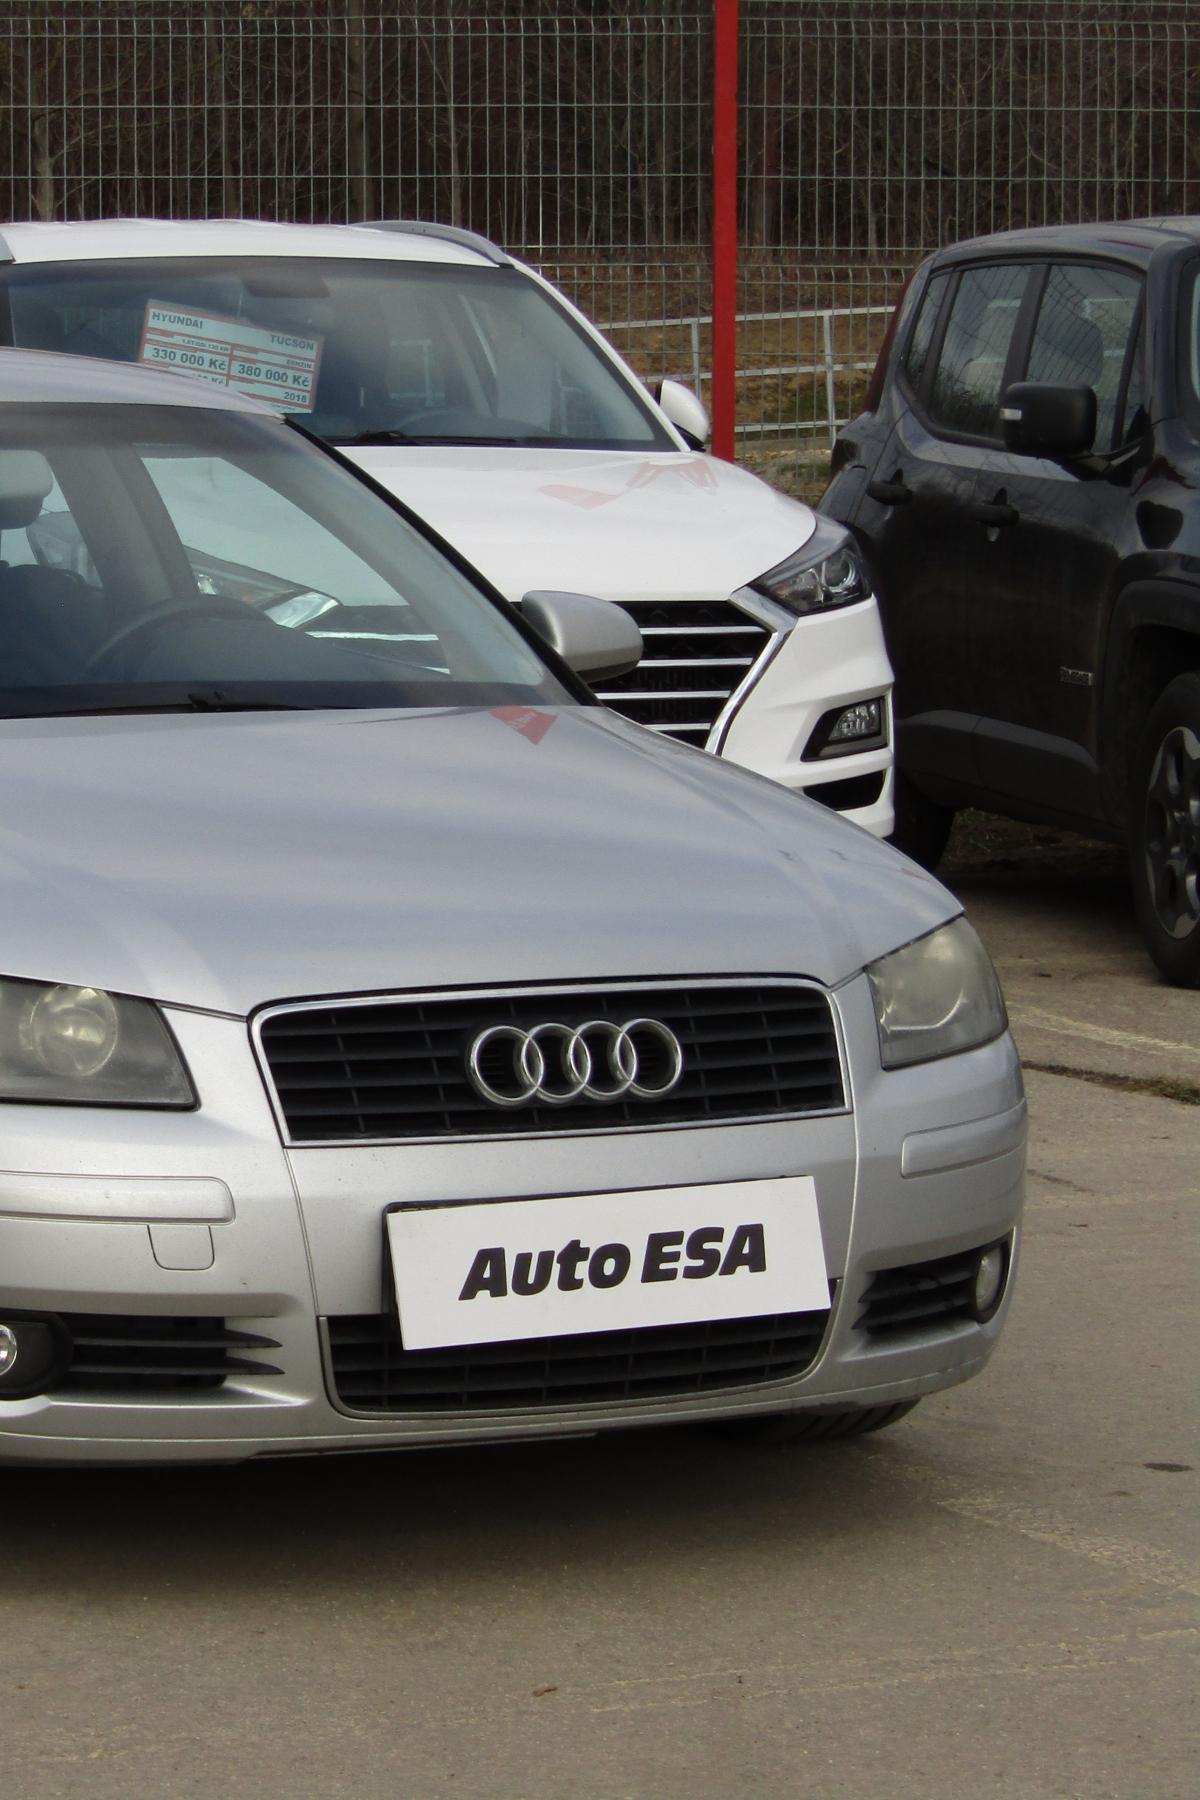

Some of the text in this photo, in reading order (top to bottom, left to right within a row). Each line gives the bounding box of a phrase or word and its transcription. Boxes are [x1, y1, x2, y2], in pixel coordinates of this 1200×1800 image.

[152, 311, 203, 329] HYUNDAI
[270, 334, 314, 351] TUCSON
[152, 347, 226, 371] 330 000 Kč
[238, 364, 310, 387] 380 000 Kč
[283, 391, 308, 404] 2018
[458, 1223, 767, 1301] Auto ESA
